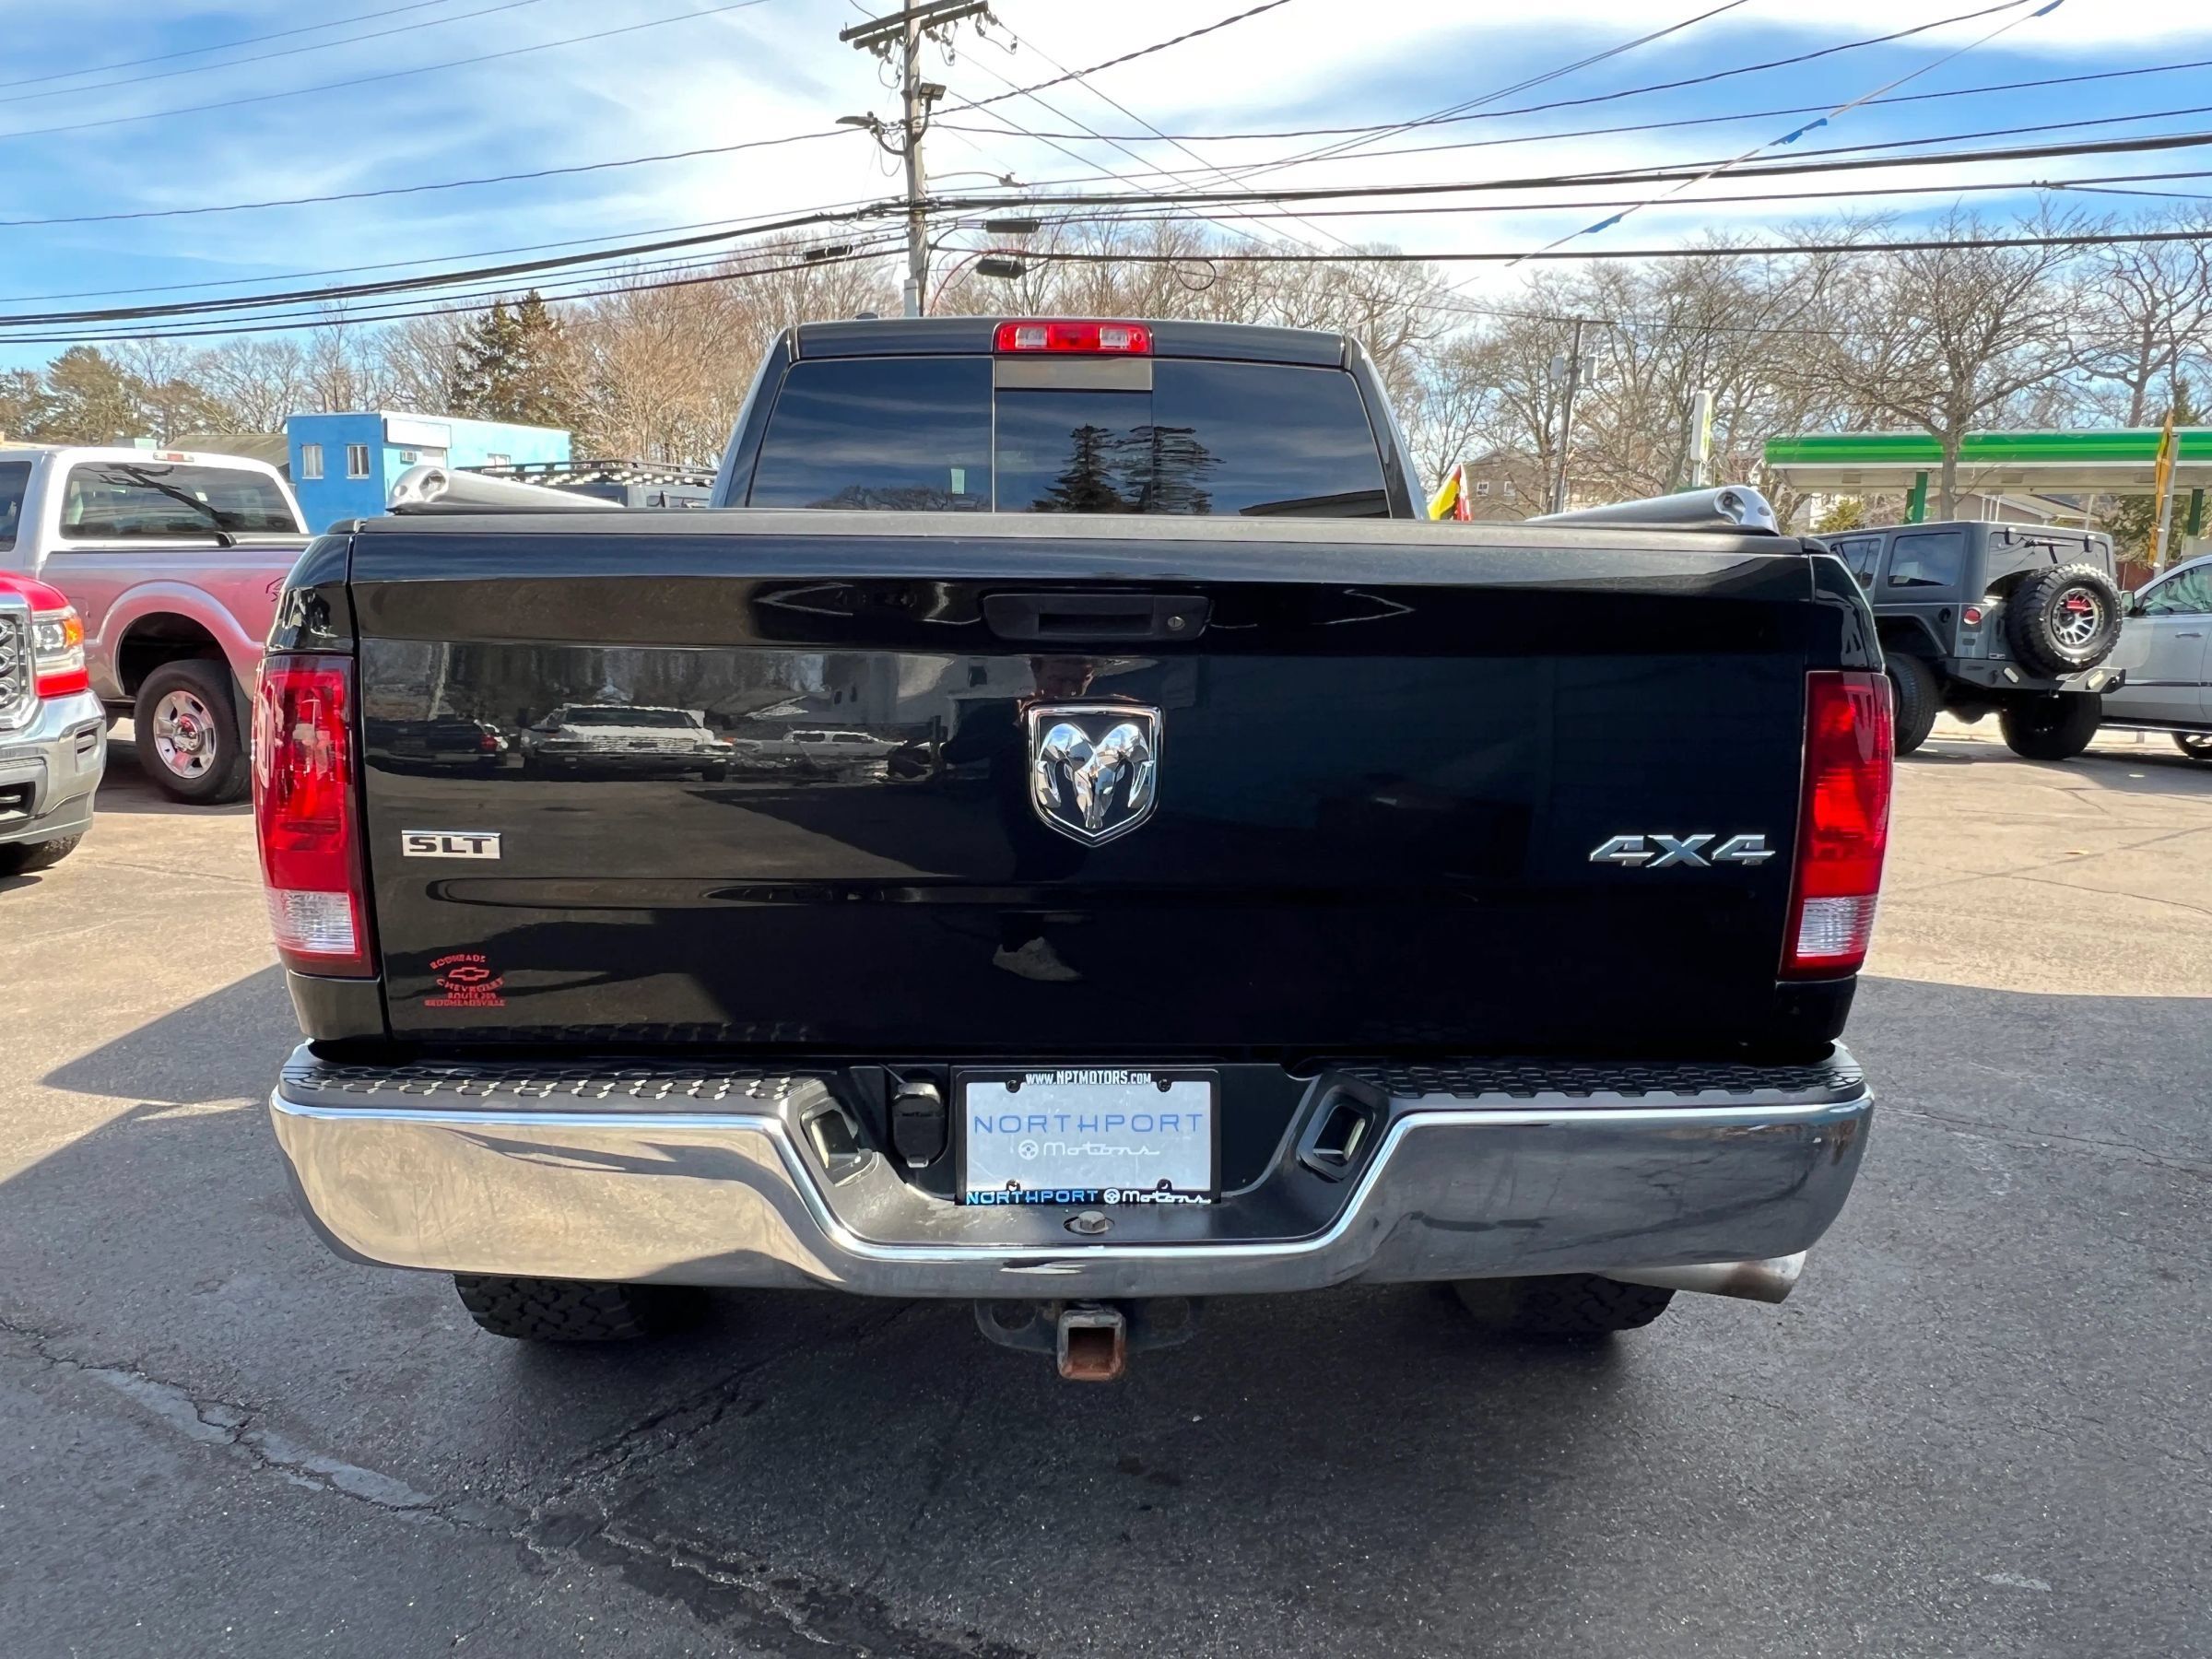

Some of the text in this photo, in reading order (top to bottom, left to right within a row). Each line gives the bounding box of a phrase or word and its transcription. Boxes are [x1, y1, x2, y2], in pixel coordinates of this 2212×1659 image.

[407, 834, 493, 855] SLT
[1589, 833, 1776, 867] 4X4
[436, 976, 504, 992] CHEVROLET
[1025, 1070, 1152, 1086] WWW.NPTMOTORS.COM
[973, 1113, 1204, 1135] NORTHPORT
[1042, 1140, 1161, 1157] Motors
[966, 1189, 1212, 1206] NORTHPORT Motors
